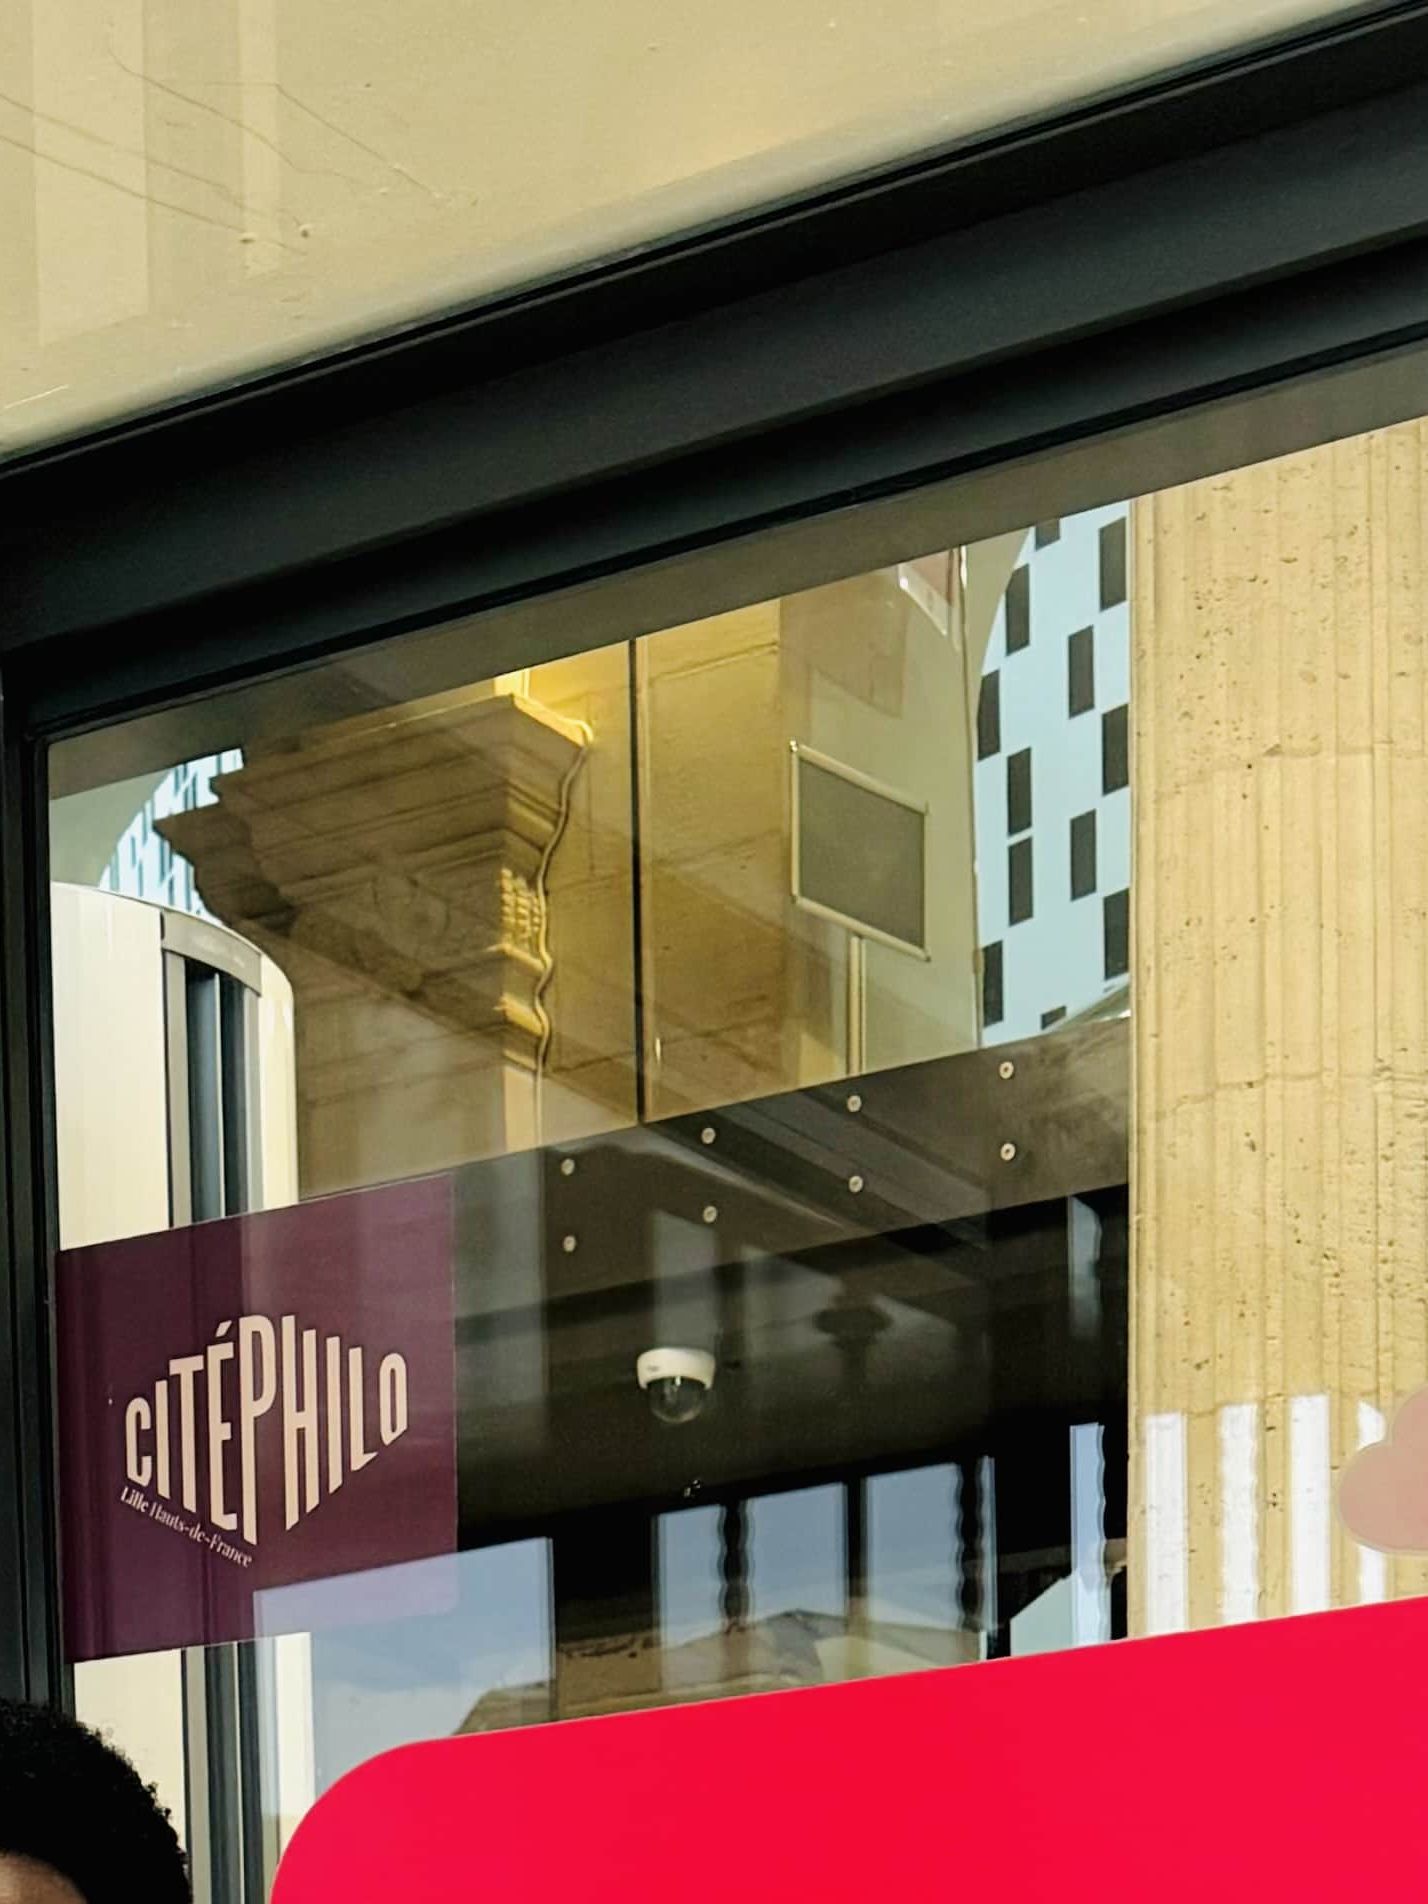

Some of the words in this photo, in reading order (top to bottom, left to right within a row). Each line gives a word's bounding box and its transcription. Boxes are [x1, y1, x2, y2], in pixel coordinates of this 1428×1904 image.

[124, 1314, 409, 1546] CITÉPHILO
[120, 1486, 150, 1513] Lille
[149, 1502, 253, 1568] Hauts-de-France
